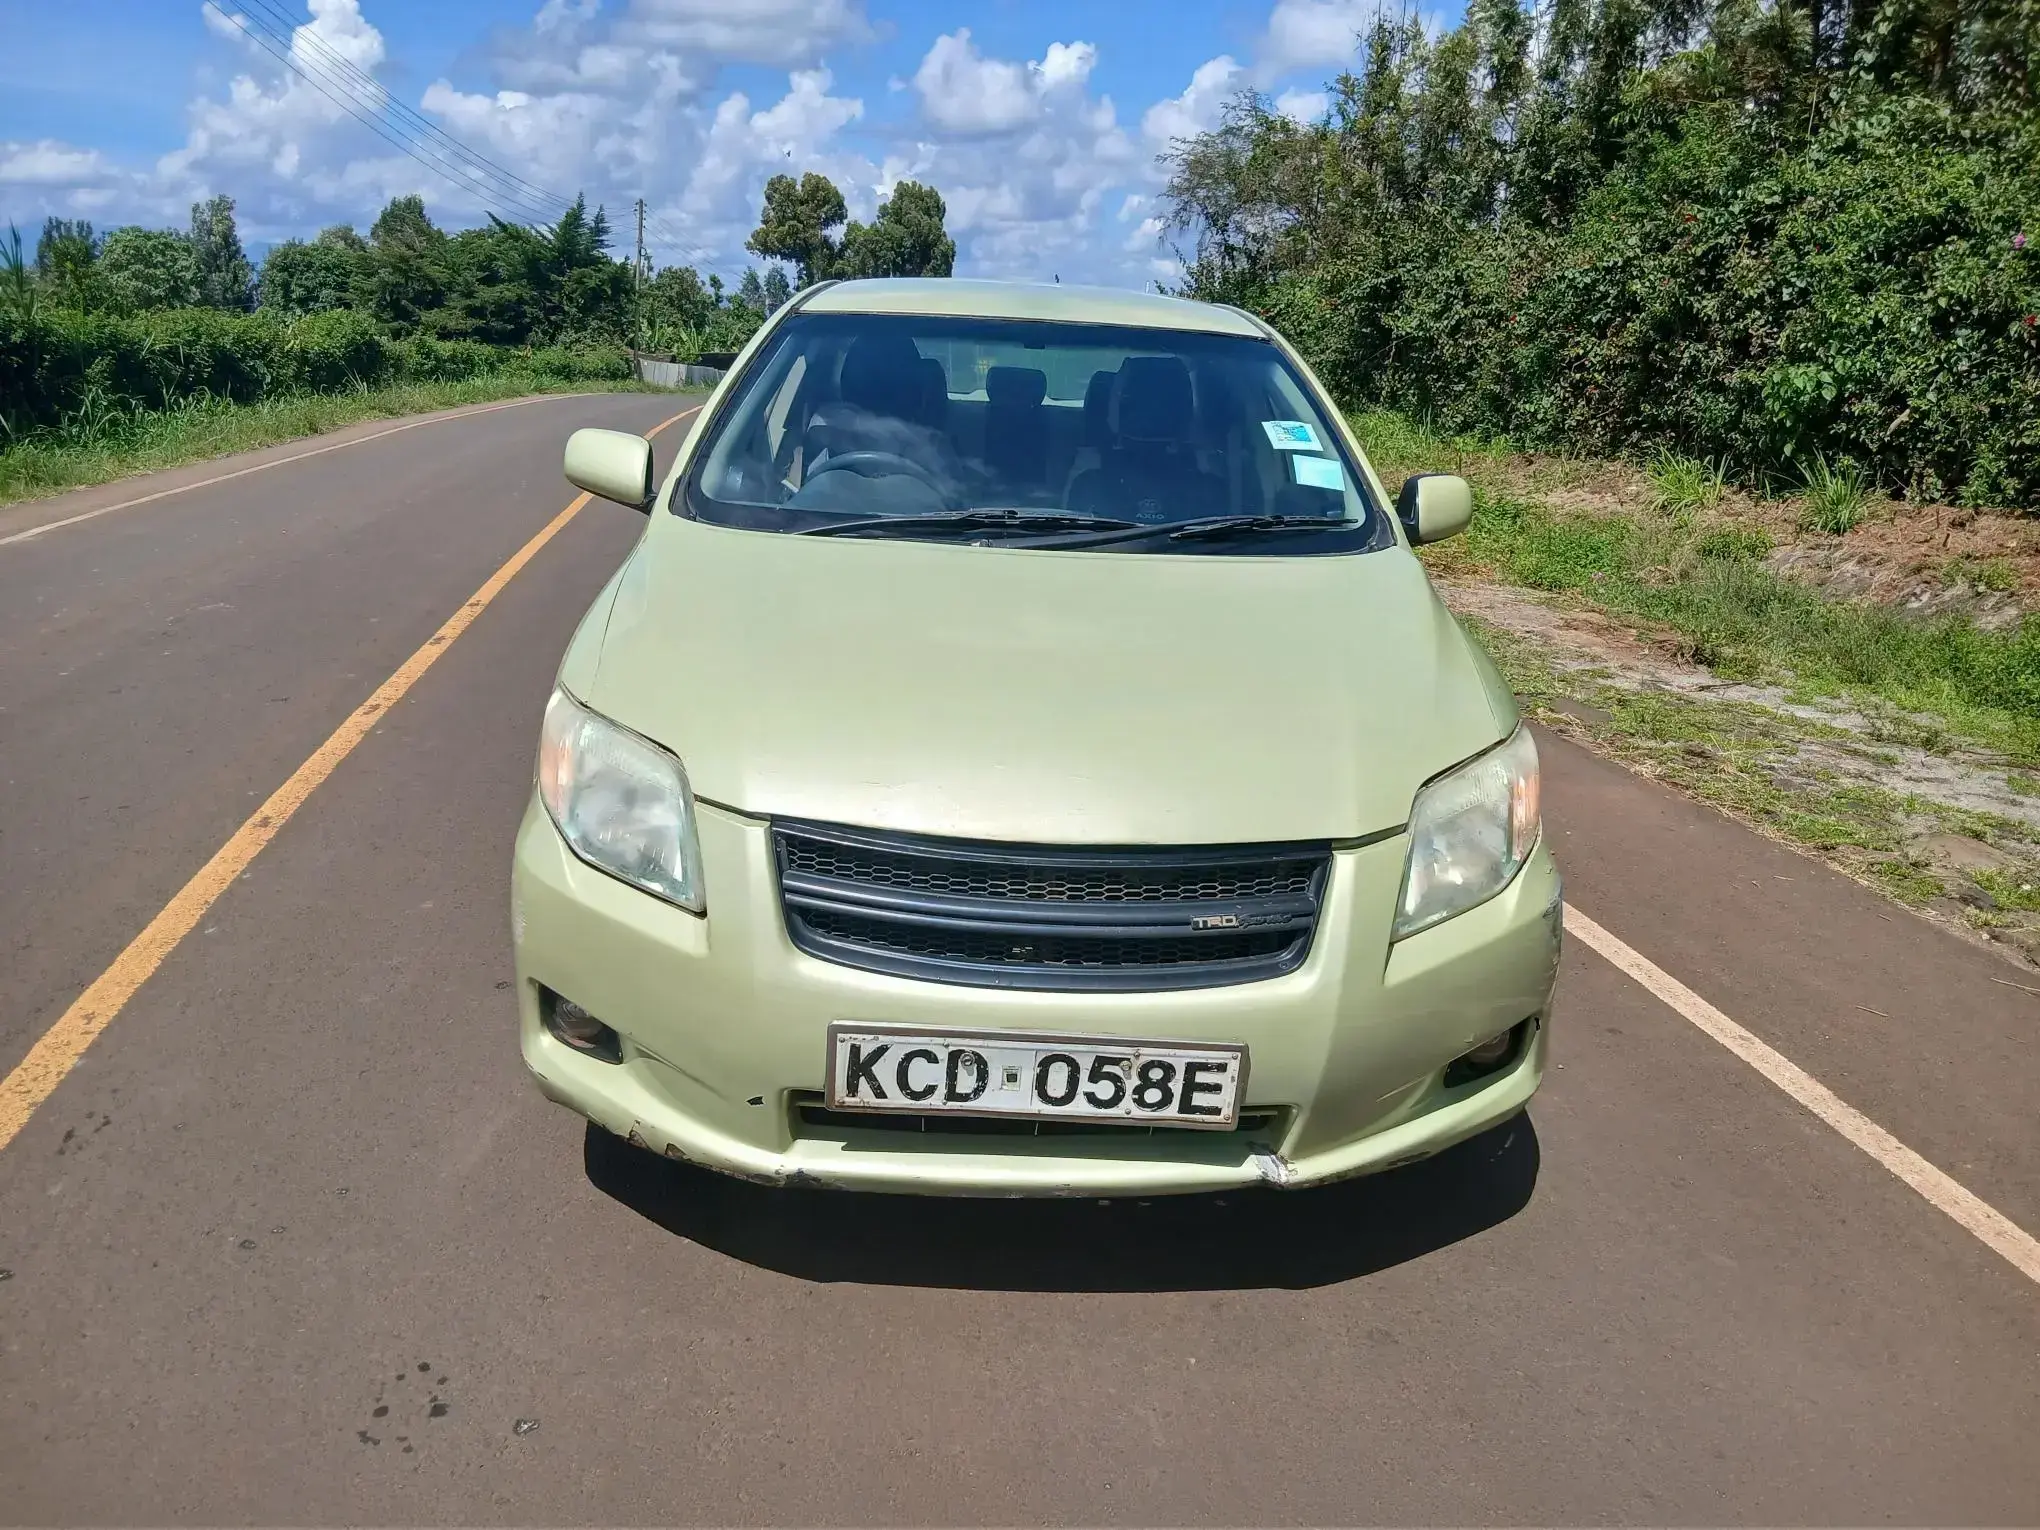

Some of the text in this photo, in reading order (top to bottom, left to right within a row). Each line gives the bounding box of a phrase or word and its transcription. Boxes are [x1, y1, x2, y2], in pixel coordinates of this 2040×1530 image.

[1192, 915, 1237, 930] TRD
[845, 1043, 1229, 1116] KCD 058E
